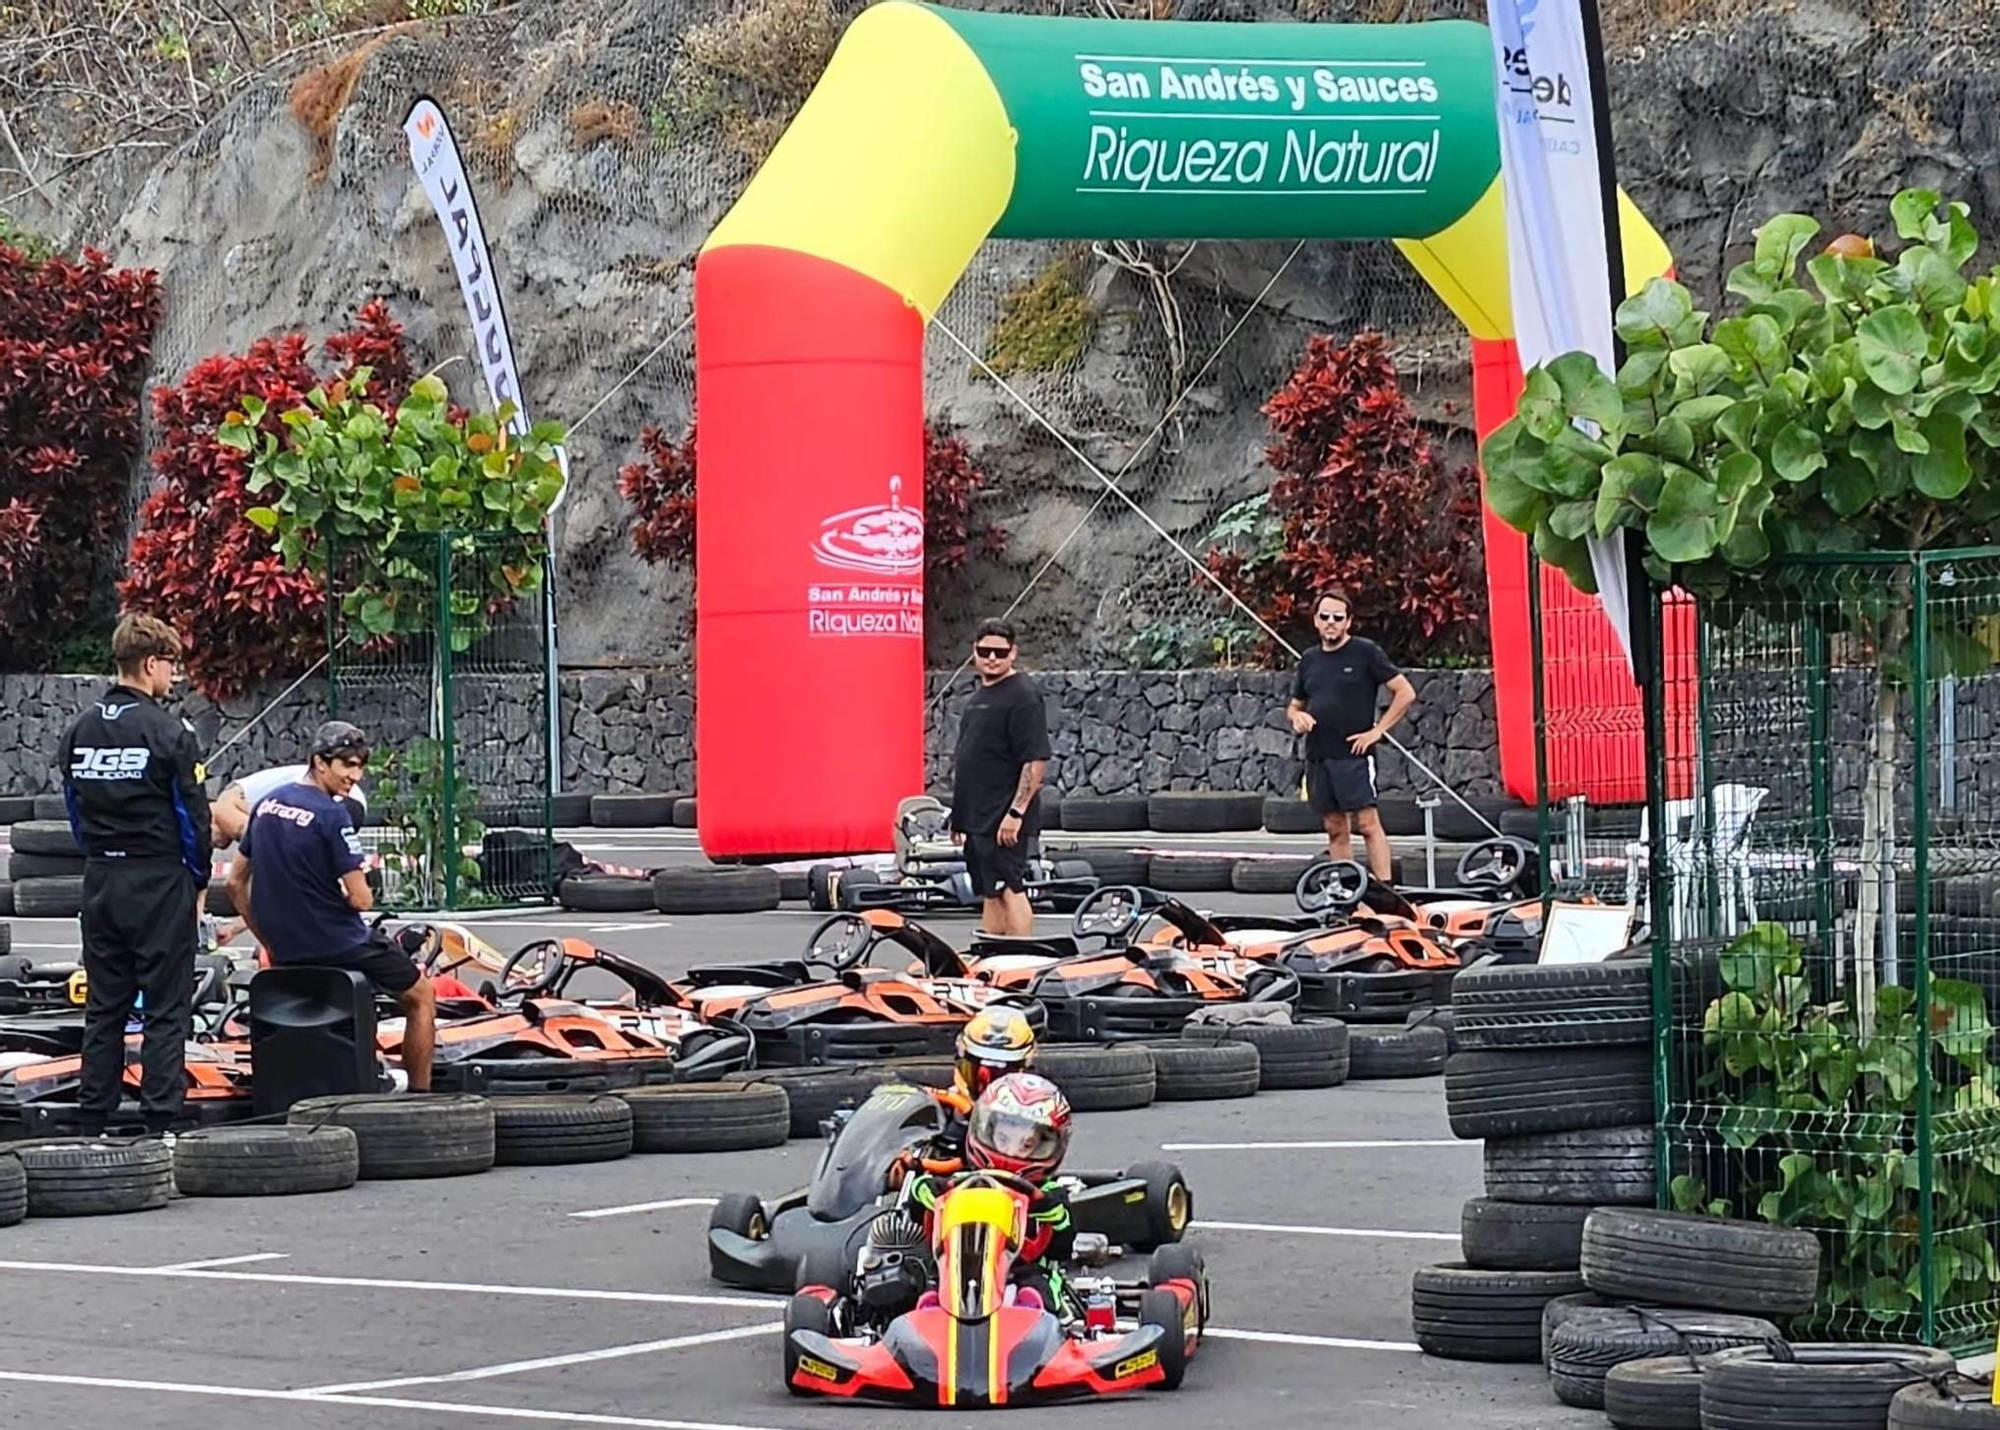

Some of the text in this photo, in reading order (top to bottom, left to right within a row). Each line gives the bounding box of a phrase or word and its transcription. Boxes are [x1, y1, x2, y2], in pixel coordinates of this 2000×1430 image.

[1080, 62, 1439, 111] San Andrés y Sauces
[1083, 125, 1440, 193] Riqueza Natural
[808, 586, 843, 602] San
[809, 609, 897, 635] Riqueza
